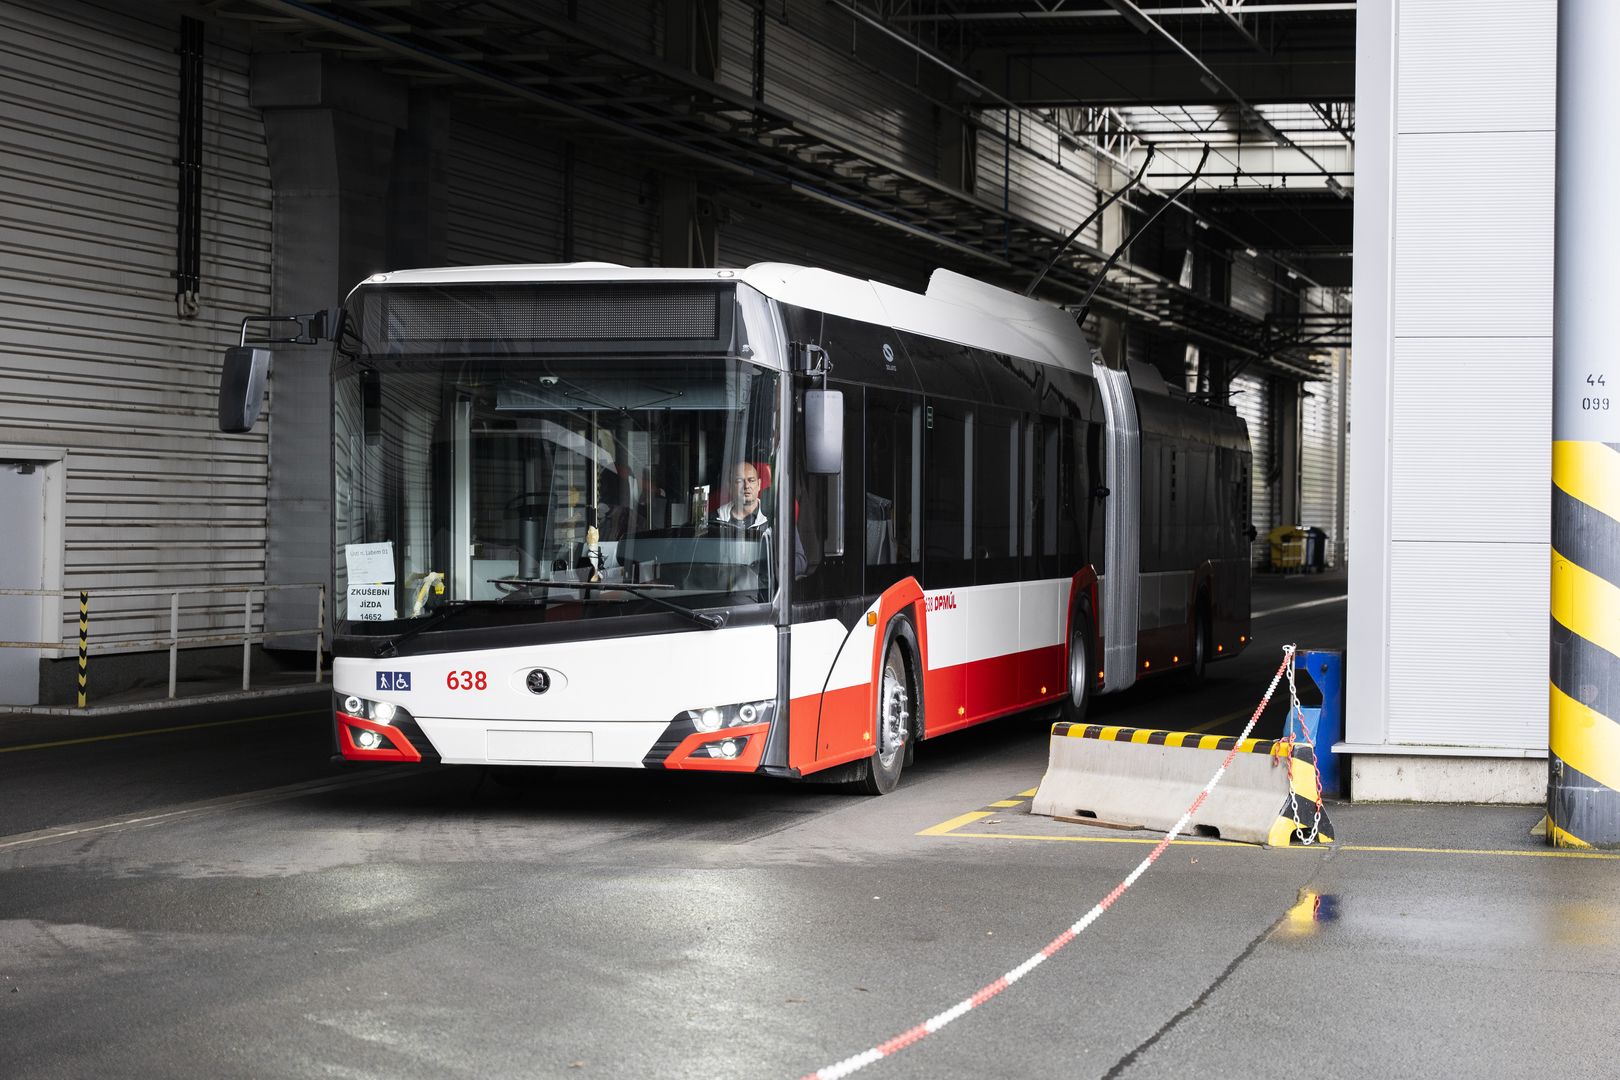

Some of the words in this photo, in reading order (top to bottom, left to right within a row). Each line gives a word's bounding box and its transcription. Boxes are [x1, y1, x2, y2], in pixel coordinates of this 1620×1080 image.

[1586, 374, 1605, 386] 44
[1582, 397, 1610, 411] 099
[350, 588, 390, 596] ZKUŠEBNÍ
[359, 600, 382, 608] JÍZDA
[934, 591, 957, 611] DPMÚL
[360, 613, 382, 621] 14652
[446, 670, 488, 691] 638
